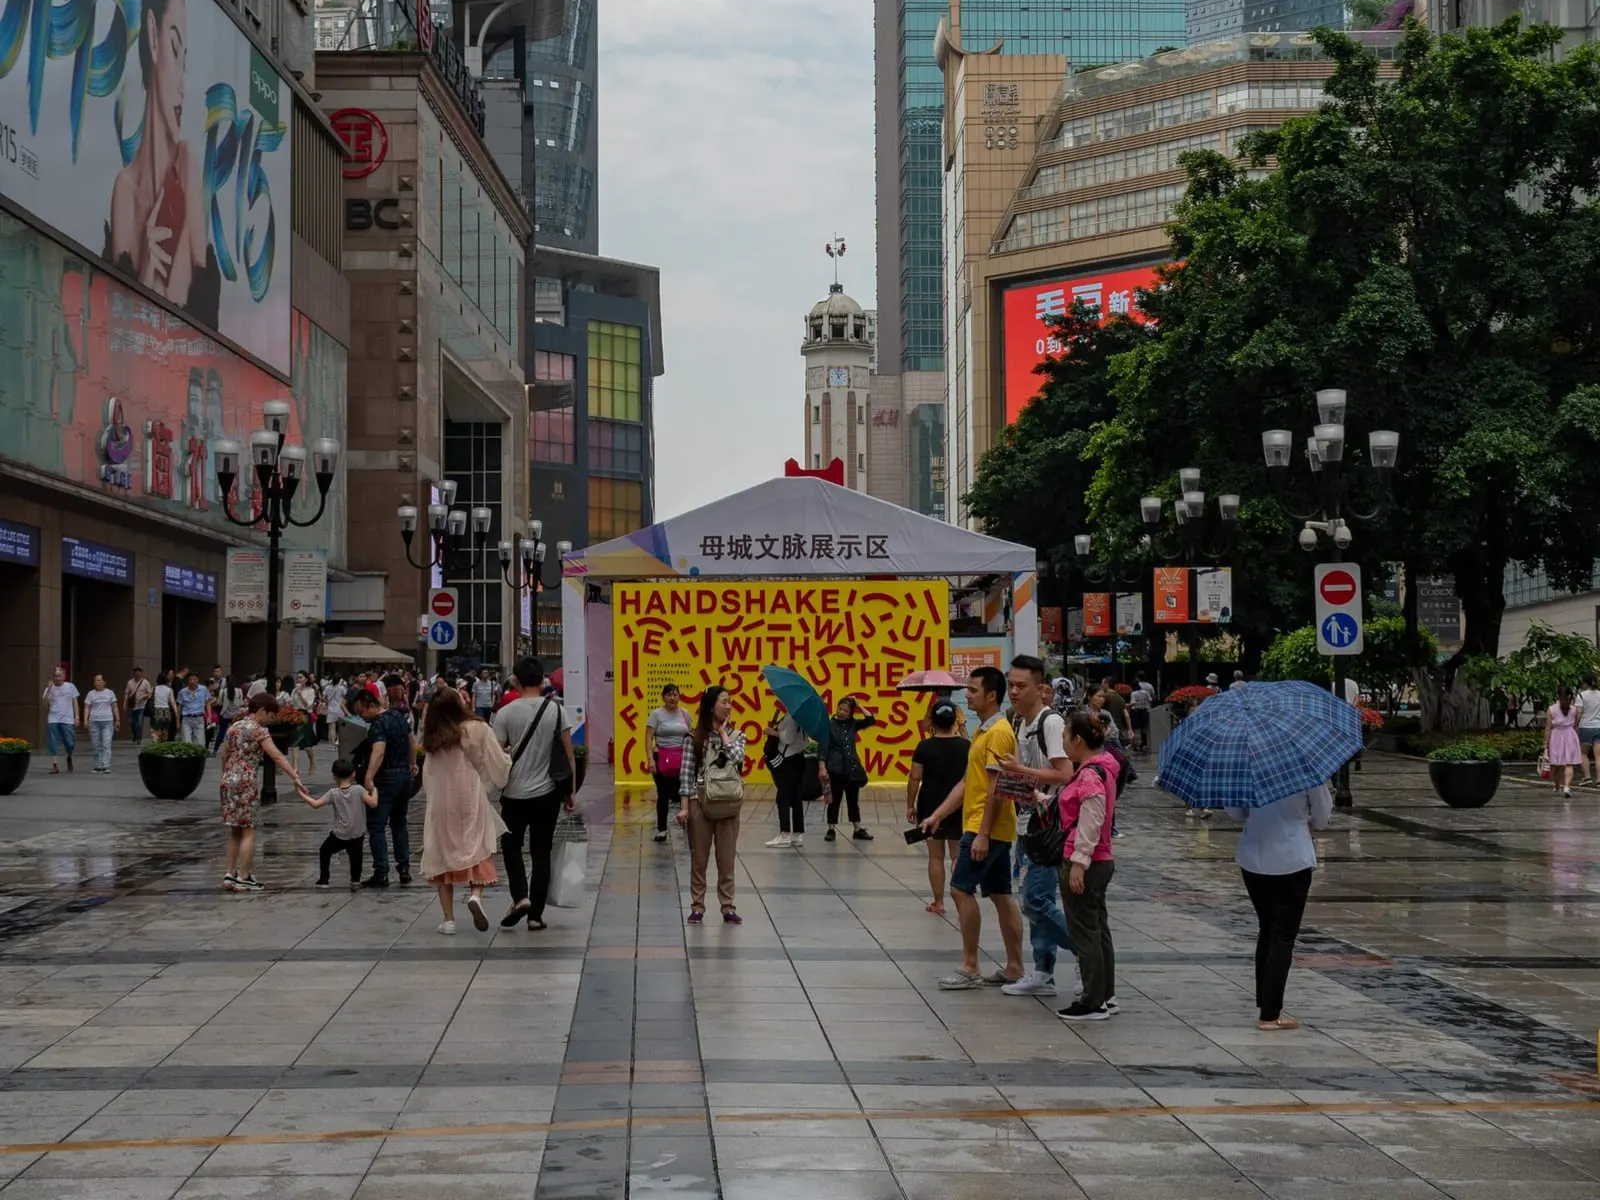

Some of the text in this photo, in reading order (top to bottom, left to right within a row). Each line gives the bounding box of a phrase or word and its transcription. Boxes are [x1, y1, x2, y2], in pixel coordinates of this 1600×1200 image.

[252, 70, 277, 104] oppo
[699, 533, 890, 561] 母城文脉展示区
[620, 589, 840, 615] HANDSHAKE
[722, 636, 810, 661] WITH
[837, 662, 904, 687] THE
